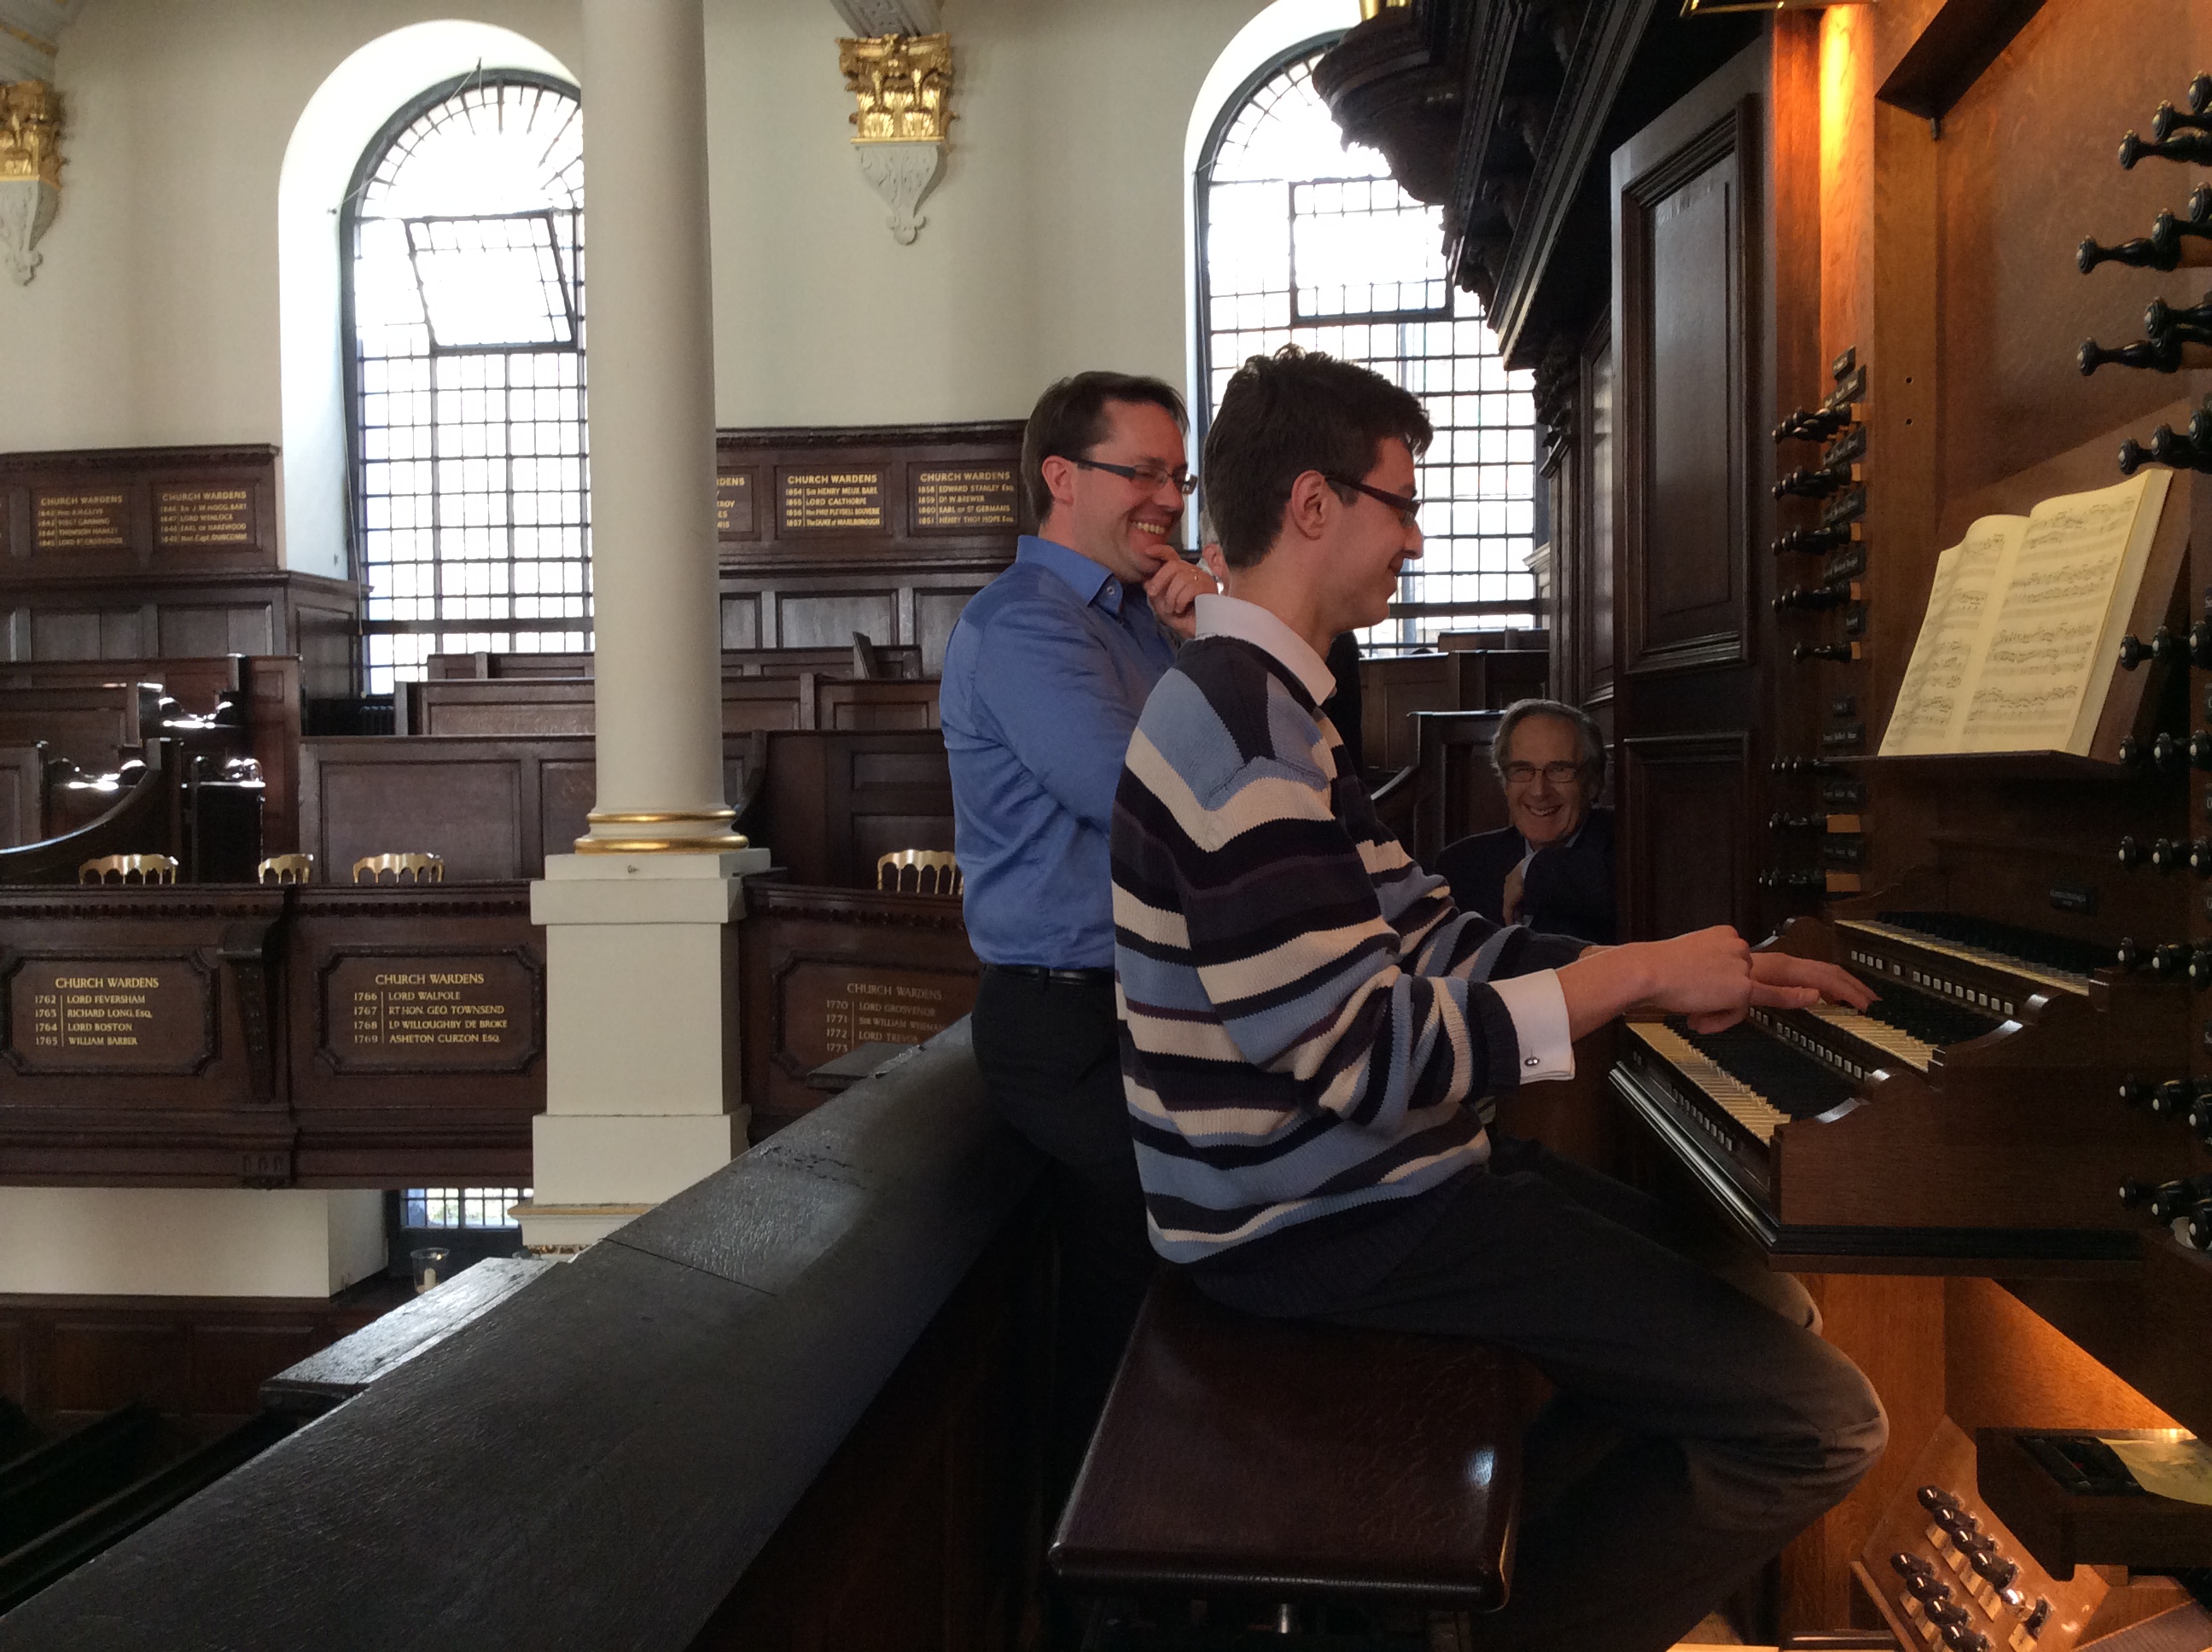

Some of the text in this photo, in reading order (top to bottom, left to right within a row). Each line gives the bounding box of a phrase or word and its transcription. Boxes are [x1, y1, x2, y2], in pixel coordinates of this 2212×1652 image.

[788, 474, 877, 484] CHURCH WARDENS
[920, 471, 1010, 482] CHURCH WARDENS
[939, 485, 968, 493] EDWARD
[41, 495, 123, 506] CHURCH WARDENS
[162, 493, 201, 502] CHURCH
[828, 497, 866, 505] CALTHORPE
[55, 977, 159, 989] CHURCH WARDENS
[375, 974, 485, 985] CHURCH WARDENS
[354, 992, 461, 1001] 1766 LORD WALPOLE
[847, 983, 942, 1001] CHURCH WARDENS
[35, 995, 145, 1004] 1762 LORD FEVERSHAM
[35, 1009, 56, 1017] 1763
[67, 1009, 105, 1017] RICHARD
[354, 1007, 377, 1015] 1767
[451, 1005, 504, 1015] TOWNSEND
[827, 1000, 935, 1017] 1770 LORD GROSVENOR
[402, 1021, 462, 1029] WILLOUGHBY
[480, 1020, 508, 1028] BROKE
[827, 1015, 847, 1023] 1771
[873, 1018, 906, 1028] WILLIAM
[36, 1023, 132, 1032] 1764 LORD BOSTON
[354, 1035, 378, 1044] 1769
[389, 1035, 434, 1044] ASHETON
[437, 1034, 479, 1043] CURZON
[827, 1028, 847, 1038] 1772
[859, 1031, 882, 1041] LORD
[36, 1036, 137, 1045] 1765 WILLIAM BARBER
[827, 1043, 848, 1052] 1773
